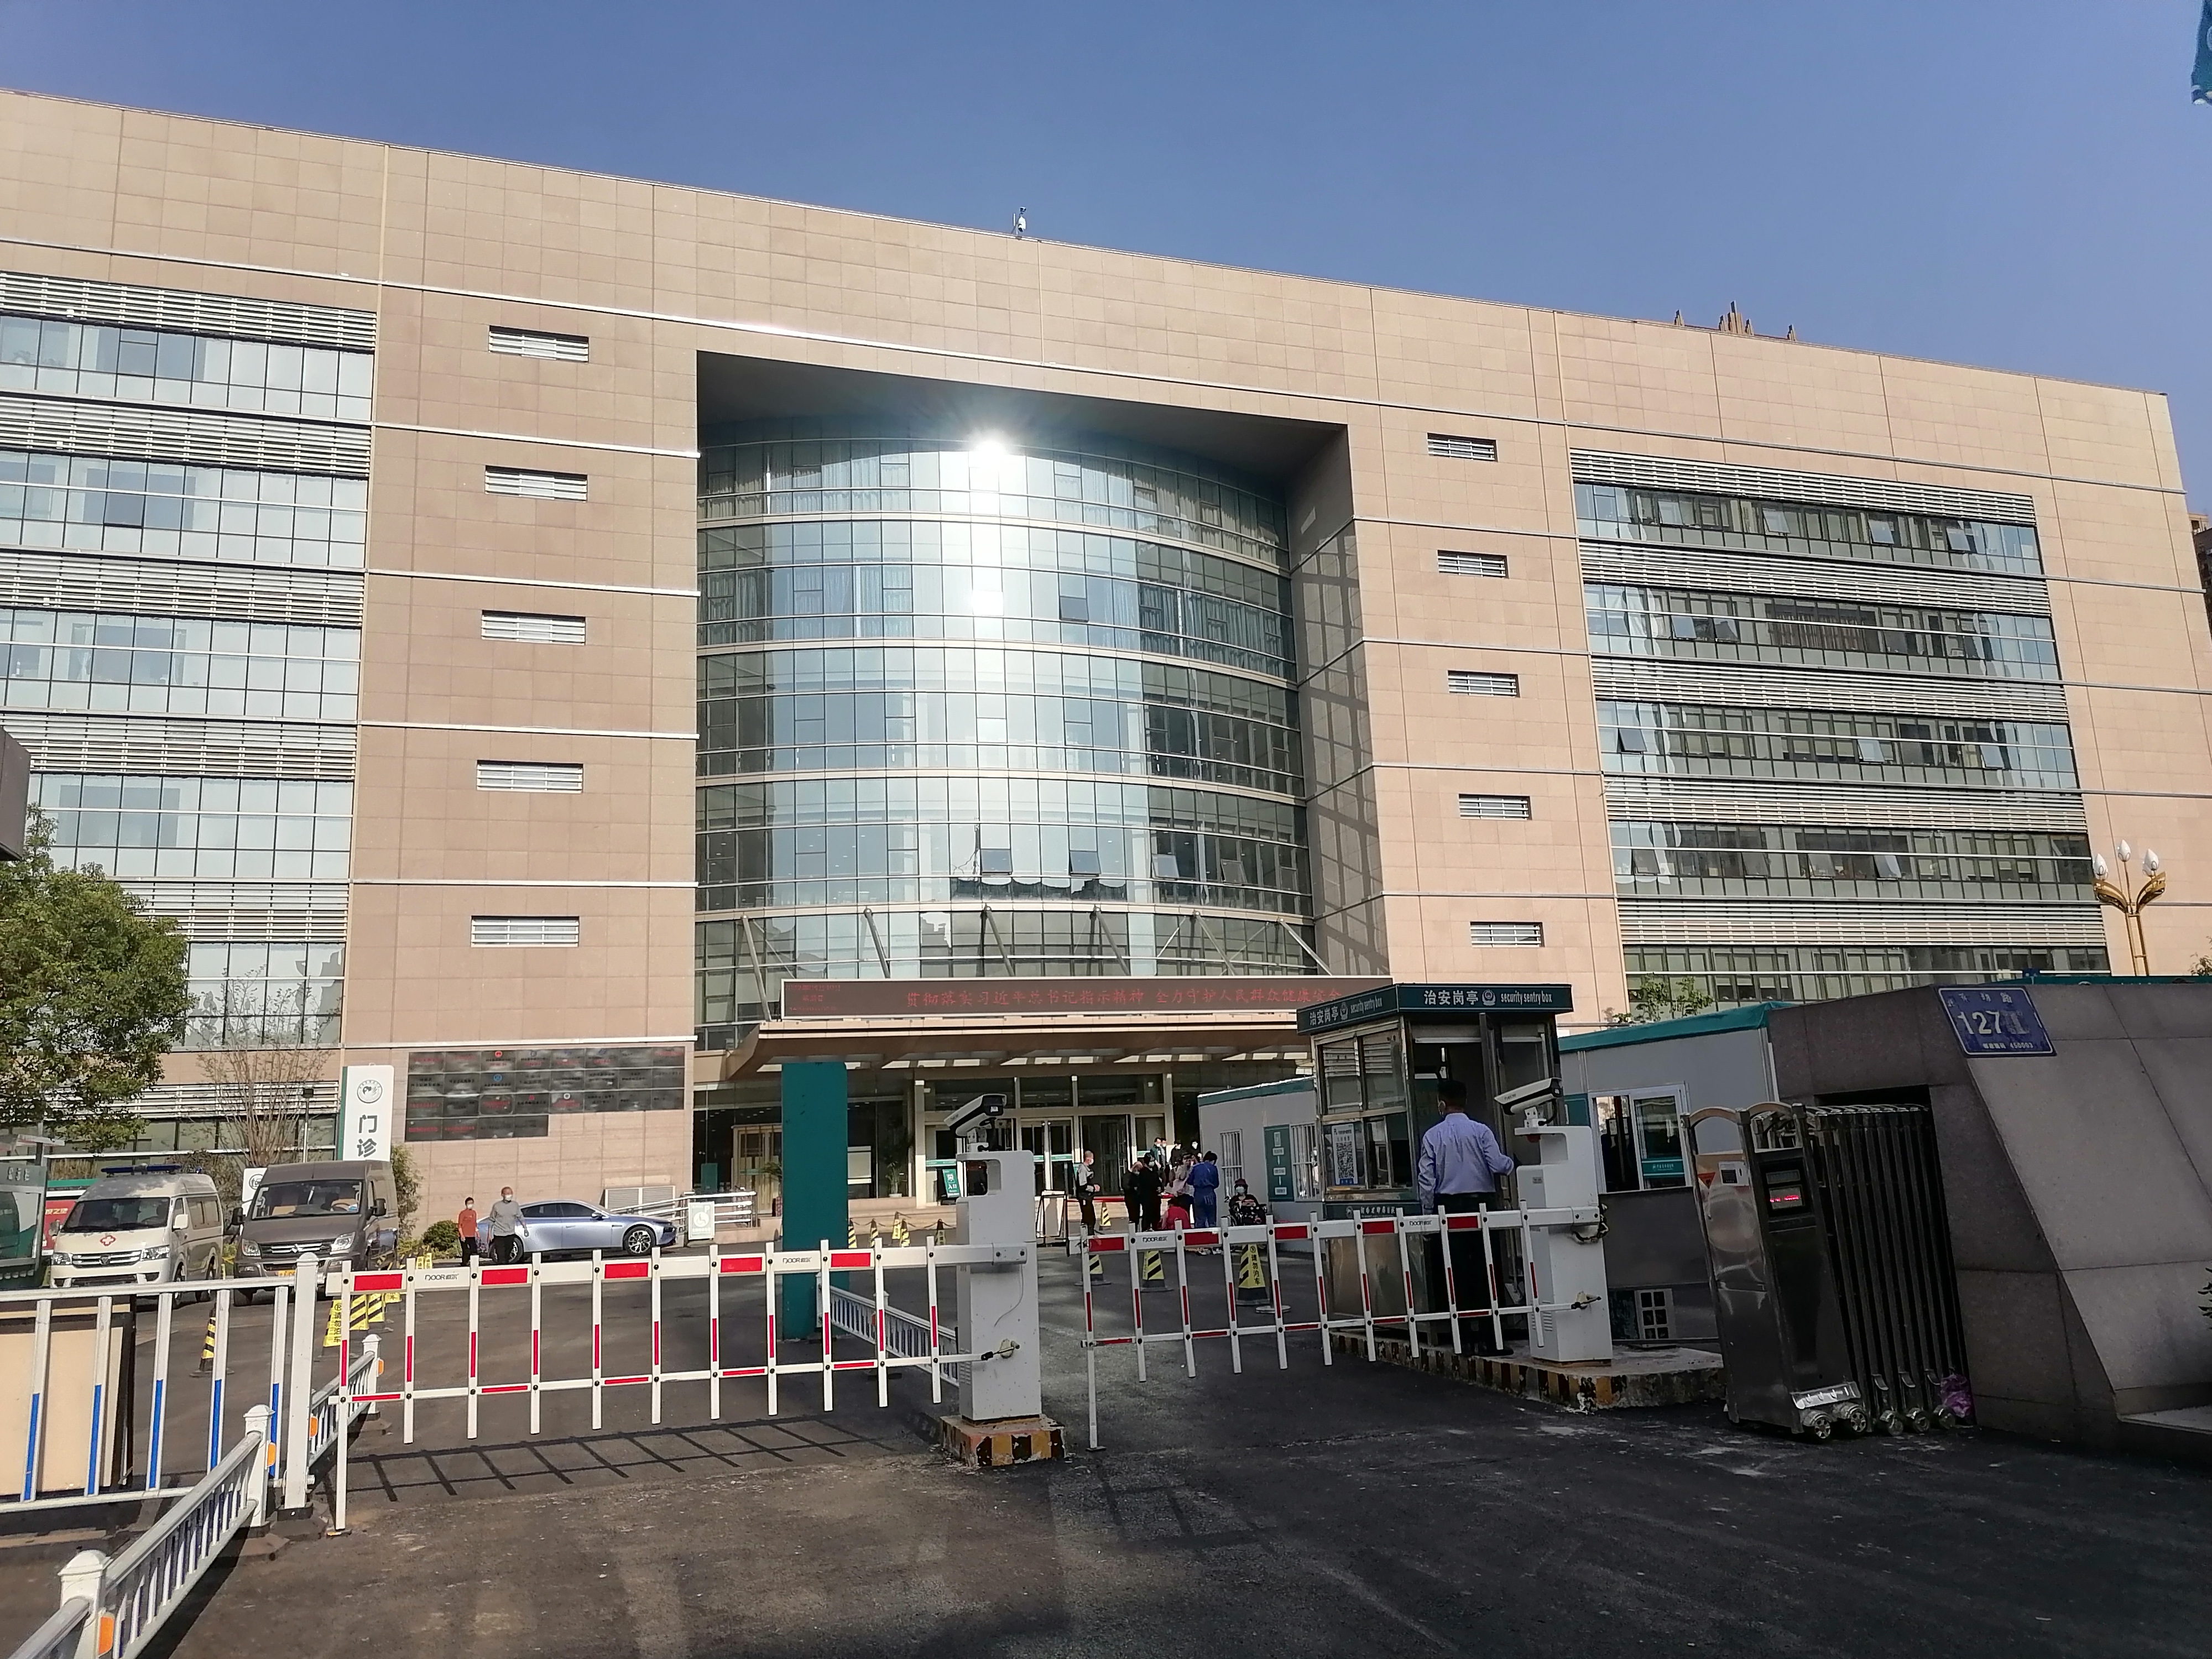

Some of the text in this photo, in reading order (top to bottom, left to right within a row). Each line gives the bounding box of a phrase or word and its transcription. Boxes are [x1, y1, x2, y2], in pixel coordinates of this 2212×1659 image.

[1424, 990, 1479, 1005] 治安岗亭
[1501, 990, 1552, 1005] security sentry box
[1310, 1006, 1338, 1026] 治安岗亭
[357, 1114, 378, 1158] 门诊
